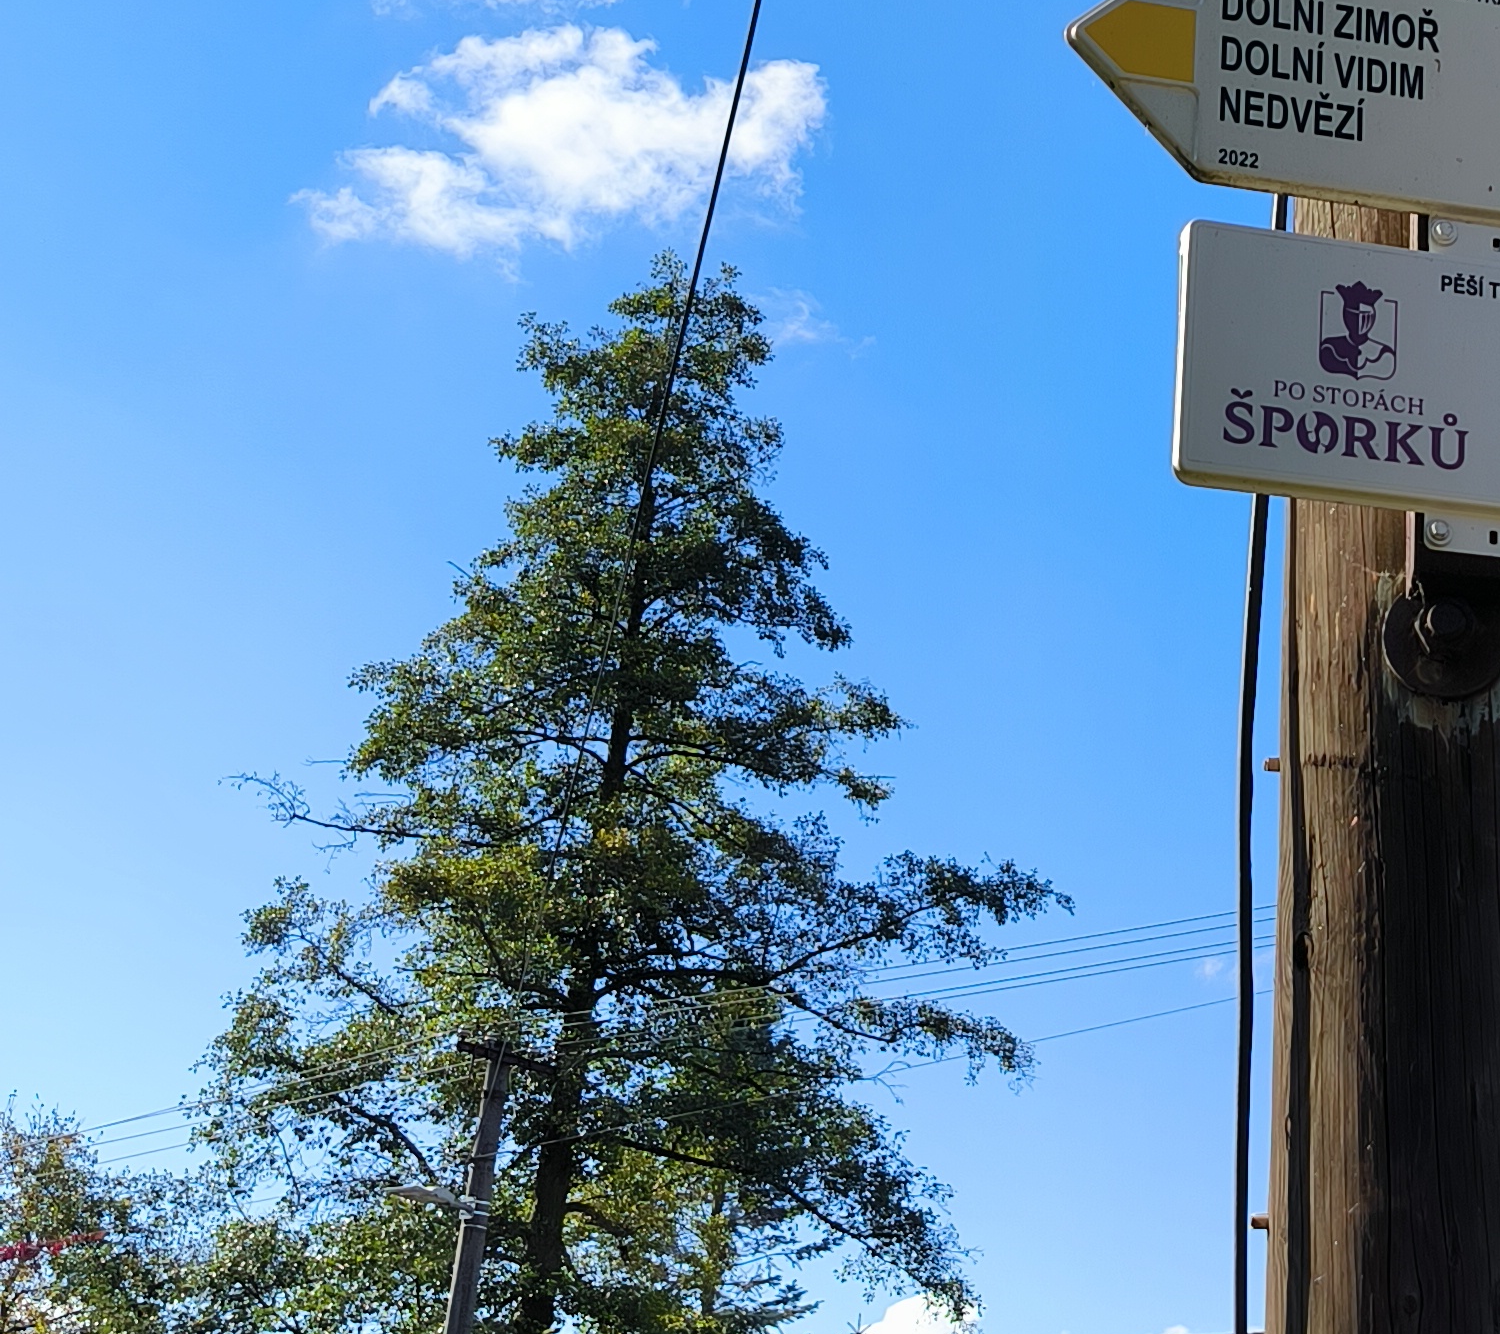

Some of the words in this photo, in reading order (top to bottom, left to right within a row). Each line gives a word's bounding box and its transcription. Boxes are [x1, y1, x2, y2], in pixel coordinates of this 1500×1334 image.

[1334, 4, 1439, 53] ZIMOŘ
[1221, 35, 1325, 85] DOLNÍ
[1334, 52, 1424, 100] VIDIM
[1219, 86, 1365, 142] NEDVĚZÍ
[1218, 148, 1259, 169] 2022
[1441, 273, 1484, 297] PĚŠÍ
[1274, 380, 1305, 400] PO
[1313, 385, 1424, 415] STOPÁCH
[1223, 388, 1469, 470] ŠPORKŮ
